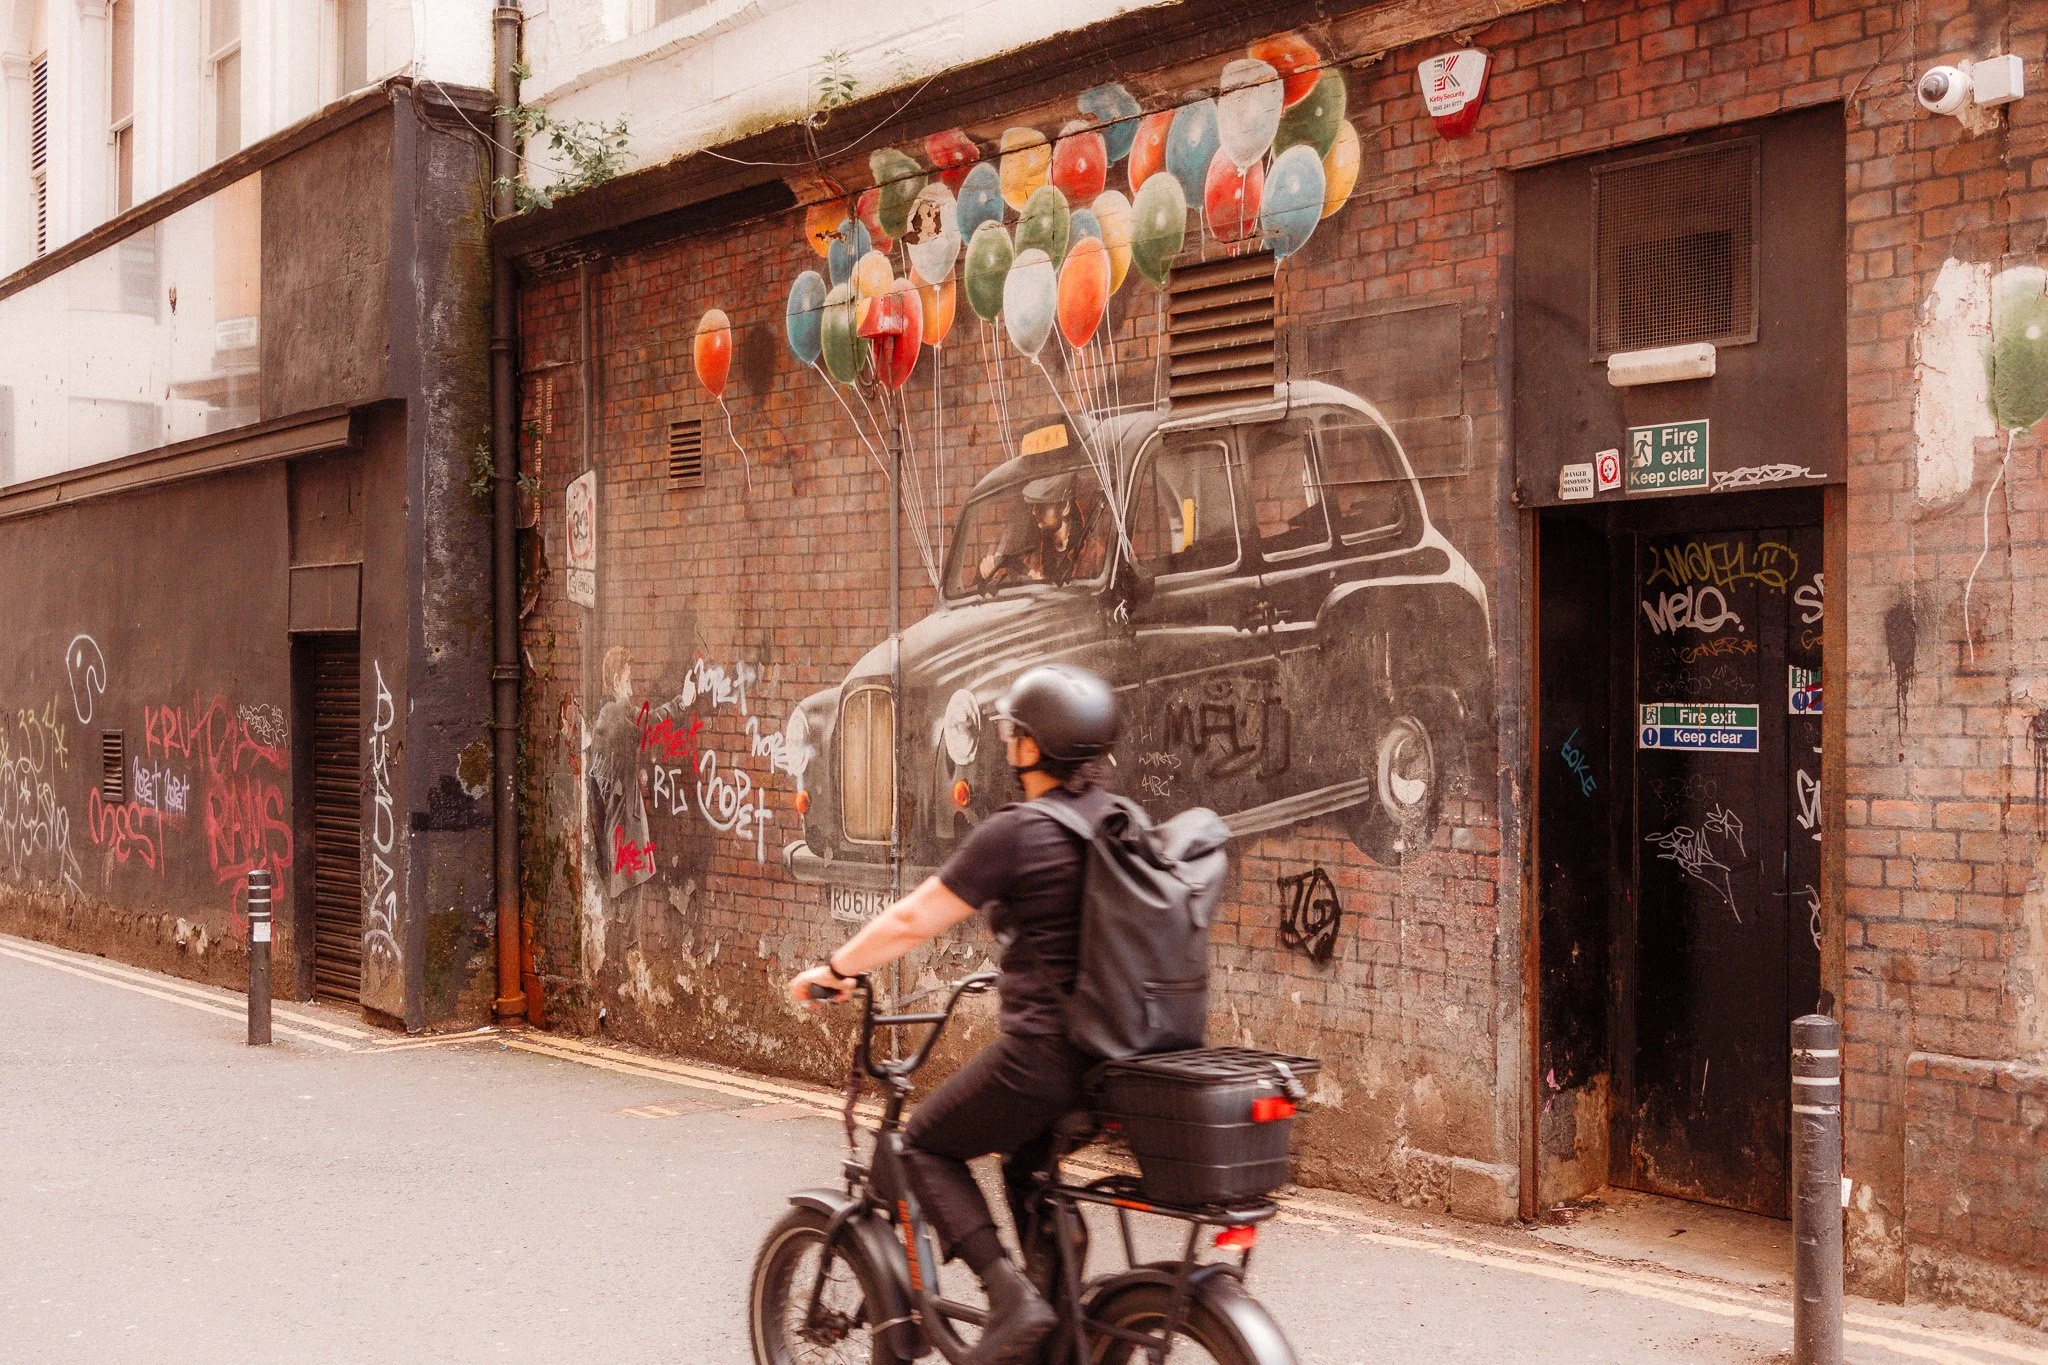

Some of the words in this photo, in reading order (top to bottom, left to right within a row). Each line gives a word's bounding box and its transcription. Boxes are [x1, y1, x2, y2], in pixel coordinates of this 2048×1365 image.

[1429, 95, 1444, 104] Kirby
[1444, 91, 1465, 100] Security
[1661, 427, 1698, 447] Fire
[1661, 447, 1696, 465] exit
[1563, 478, 1591, 486] OISONOUS
[1564, 470, 1587, 478] DANGER
[1630, 470, 1666, 486] Keep
[1669, 467, 1704, 482] clear
[1679, 709, 1707, 725] Fire
[1711, 710, 1737, 725] exit
[1674, 730, 1707, 746] Keep
[1710, 730, 1743, 744] clear
